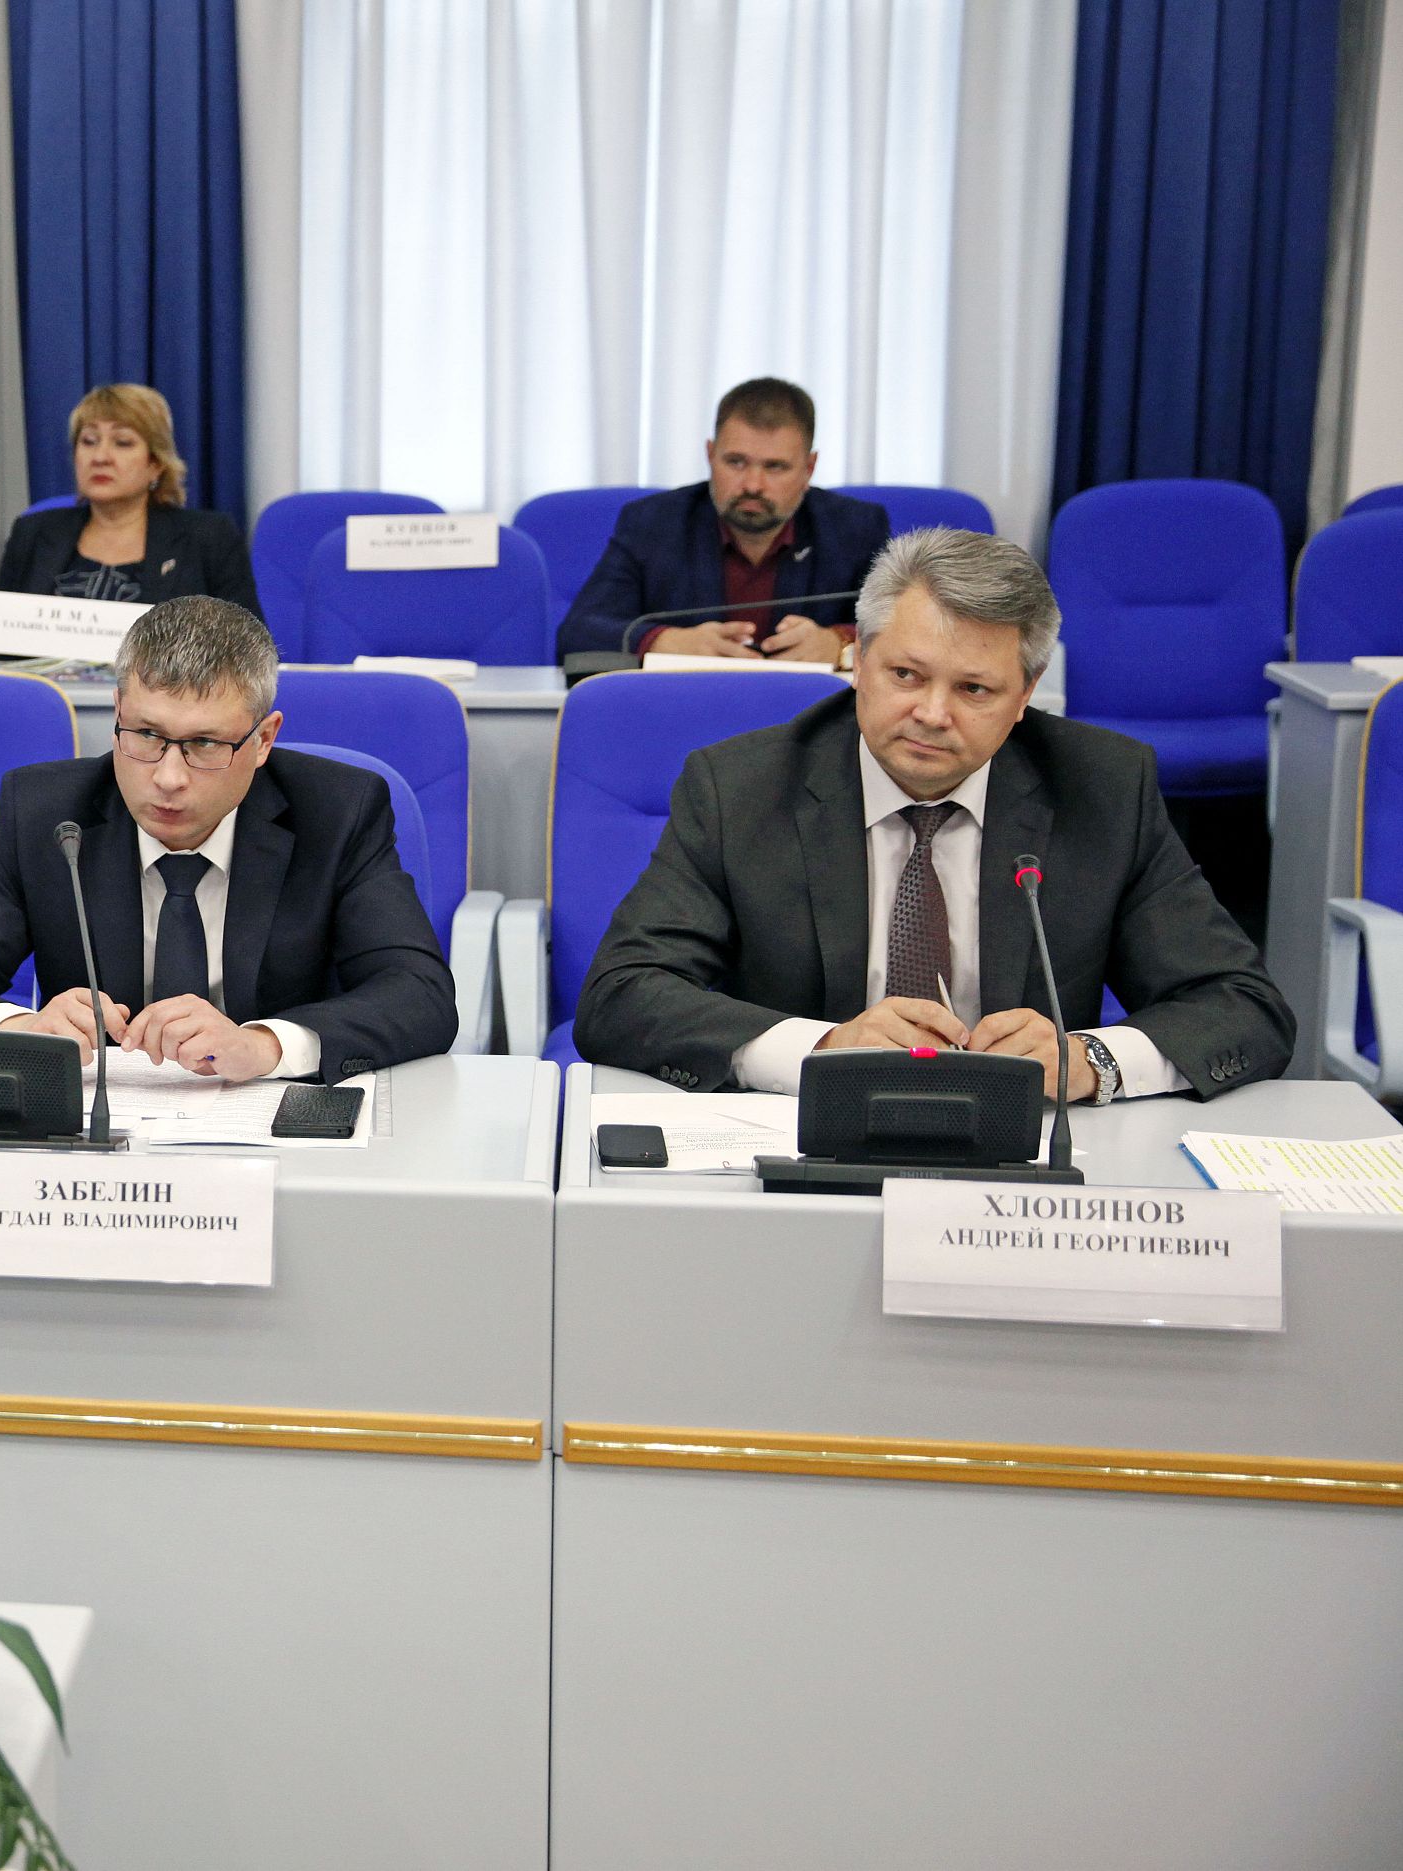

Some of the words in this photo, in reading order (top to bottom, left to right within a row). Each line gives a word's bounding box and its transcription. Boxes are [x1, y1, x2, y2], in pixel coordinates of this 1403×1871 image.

[34, 1179, 173, 1203] ЗАБЕЛИН
[63, 1212, 238, 1231] ВЛАДИМИРОВИЧ
[983, 1193, 1185, 1224] ХЛОПЯНОВ
[939, 1227, 1044, 1250] АНДРЕЙ
[1053, 1231, 1231, 1258] ГЕОРГИЕВИЧ
